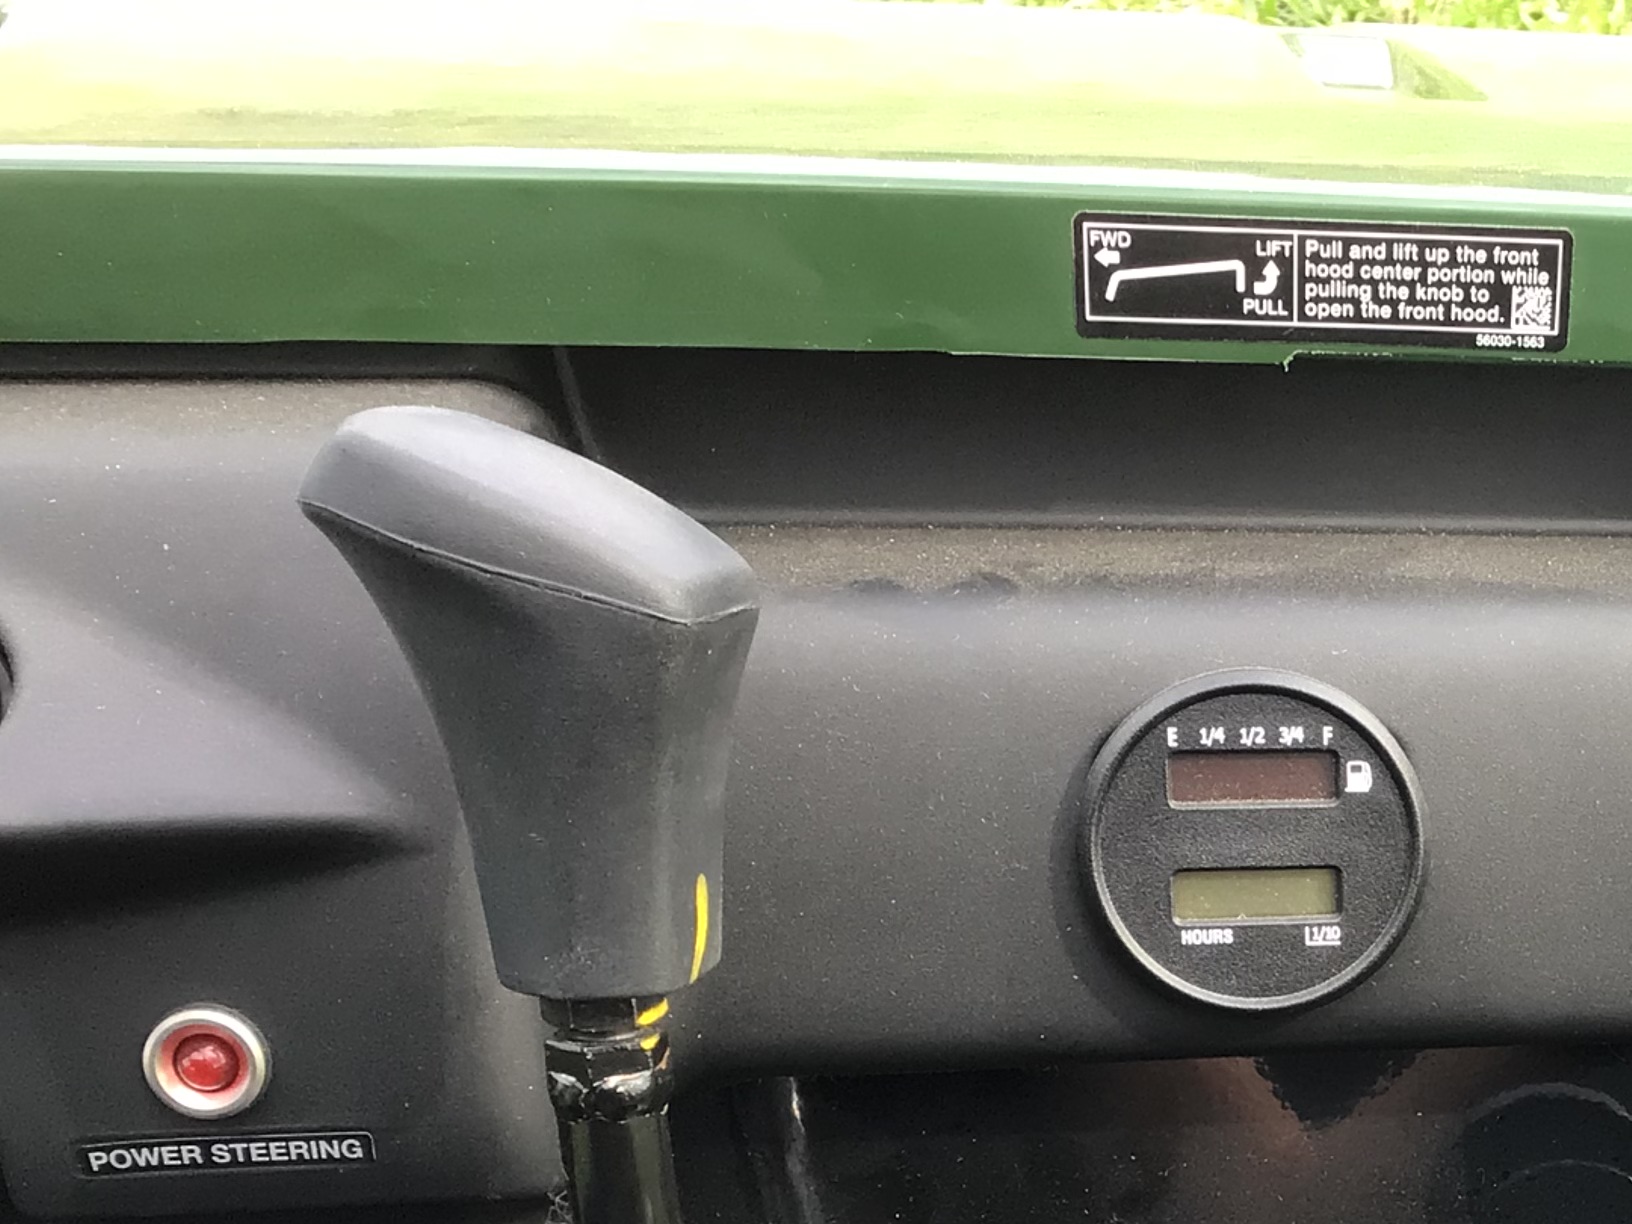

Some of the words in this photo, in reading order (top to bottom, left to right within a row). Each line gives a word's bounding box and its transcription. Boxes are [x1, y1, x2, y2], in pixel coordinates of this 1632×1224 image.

[1089, 231, 1131, 248] FWD
[1256, 240, 1293, 257] LIFT
[1305, 239, 1342, 258] Pull
[1349, 242, 1386, 260] and
[1392, 242, 1419, 261] lift
[1424, 247, 1450, 266] up
[1456, 245, 1487, 264] the
[1493, 246, 1539, 266] front
[1305, 259, 1354, 279] hood
[1359, 263, 1422, 281] center
[1427, 265, 1495, 285] portion
[1501, 267, 1549, 286] while
[1305, 280, 1372, 302] pulling
[1378, 281, 1410, 300] the
[1416, 283, 1464, 302] knob
[1470, 285, 1490, 303] to
[1243, 299, 1288, 317] PULL
[1304, 302, 1354, 320] open
[1360, 301, 1392, 319] the
[1397, 301, 1445, 321] front
[1450, 303, 1505, 323] hood.
[1475, 333, 1545, 349] 56030-1563
[1167, 727, 1178, 747] E
[1199, 727, 1225, 746] 1/4
[1239, 727, 1266, 745] 1/2
[1279, 727, 1304, 745] 3/4
[1322, 726, 1333, 745] F
[1181, 928, 1233, 946] HOURS
[88, 1144, 203, 1172] POWER
[211, 1138, 364, 1163] STEERING
